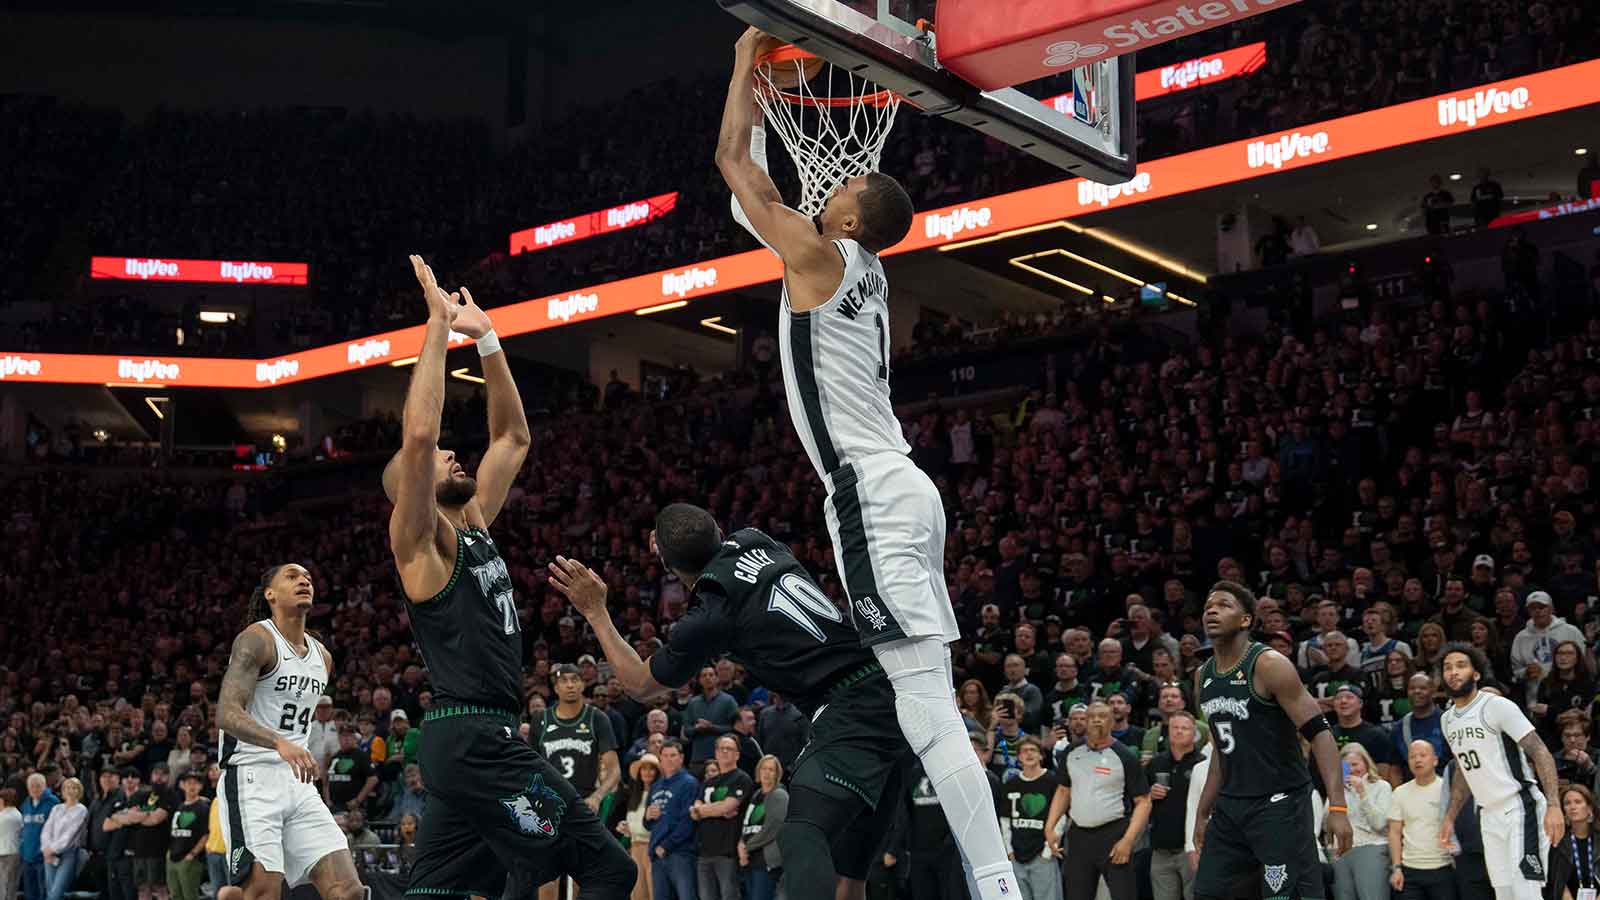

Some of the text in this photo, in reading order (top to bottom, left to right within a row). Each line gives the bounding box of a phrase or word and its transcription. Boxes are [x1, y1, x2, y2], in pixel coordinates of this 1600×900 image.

[1103, 0, 1276, 49] State
[1160, 58, 1223, 89] HyVee
[1438, 87, 1529, 127] HyVee
[1247, 132, 1329, 169] HyVee
[925, 207, 992, 240] HyVee
[125, 258, 179, 280] HyVee
[220, 260, 274, 283] HyVee
[661, 267, 717, 297] HyVee
[547, 292, 598, 322] HyVee
[346, 339, 391, 366] HyVee
[0, 358, 42, 381] yVee
[117, 358, 181, 383] HyVee
[255, 358, 299, 385] HyVee
[950, 365, 976, 383] 110
[733, 548, 777, 585] CONLEY
[766, 572, 843, 644] 10
[274, 674, 327, 696] SPURS
[279, 702, 312, 735] 24
[1214, 721, 1237, 755] 5
[1448, 727, 1486, 743] PURS
[559, 755, 576, 779] 3
[1457, 749, 1482, 772] 30
